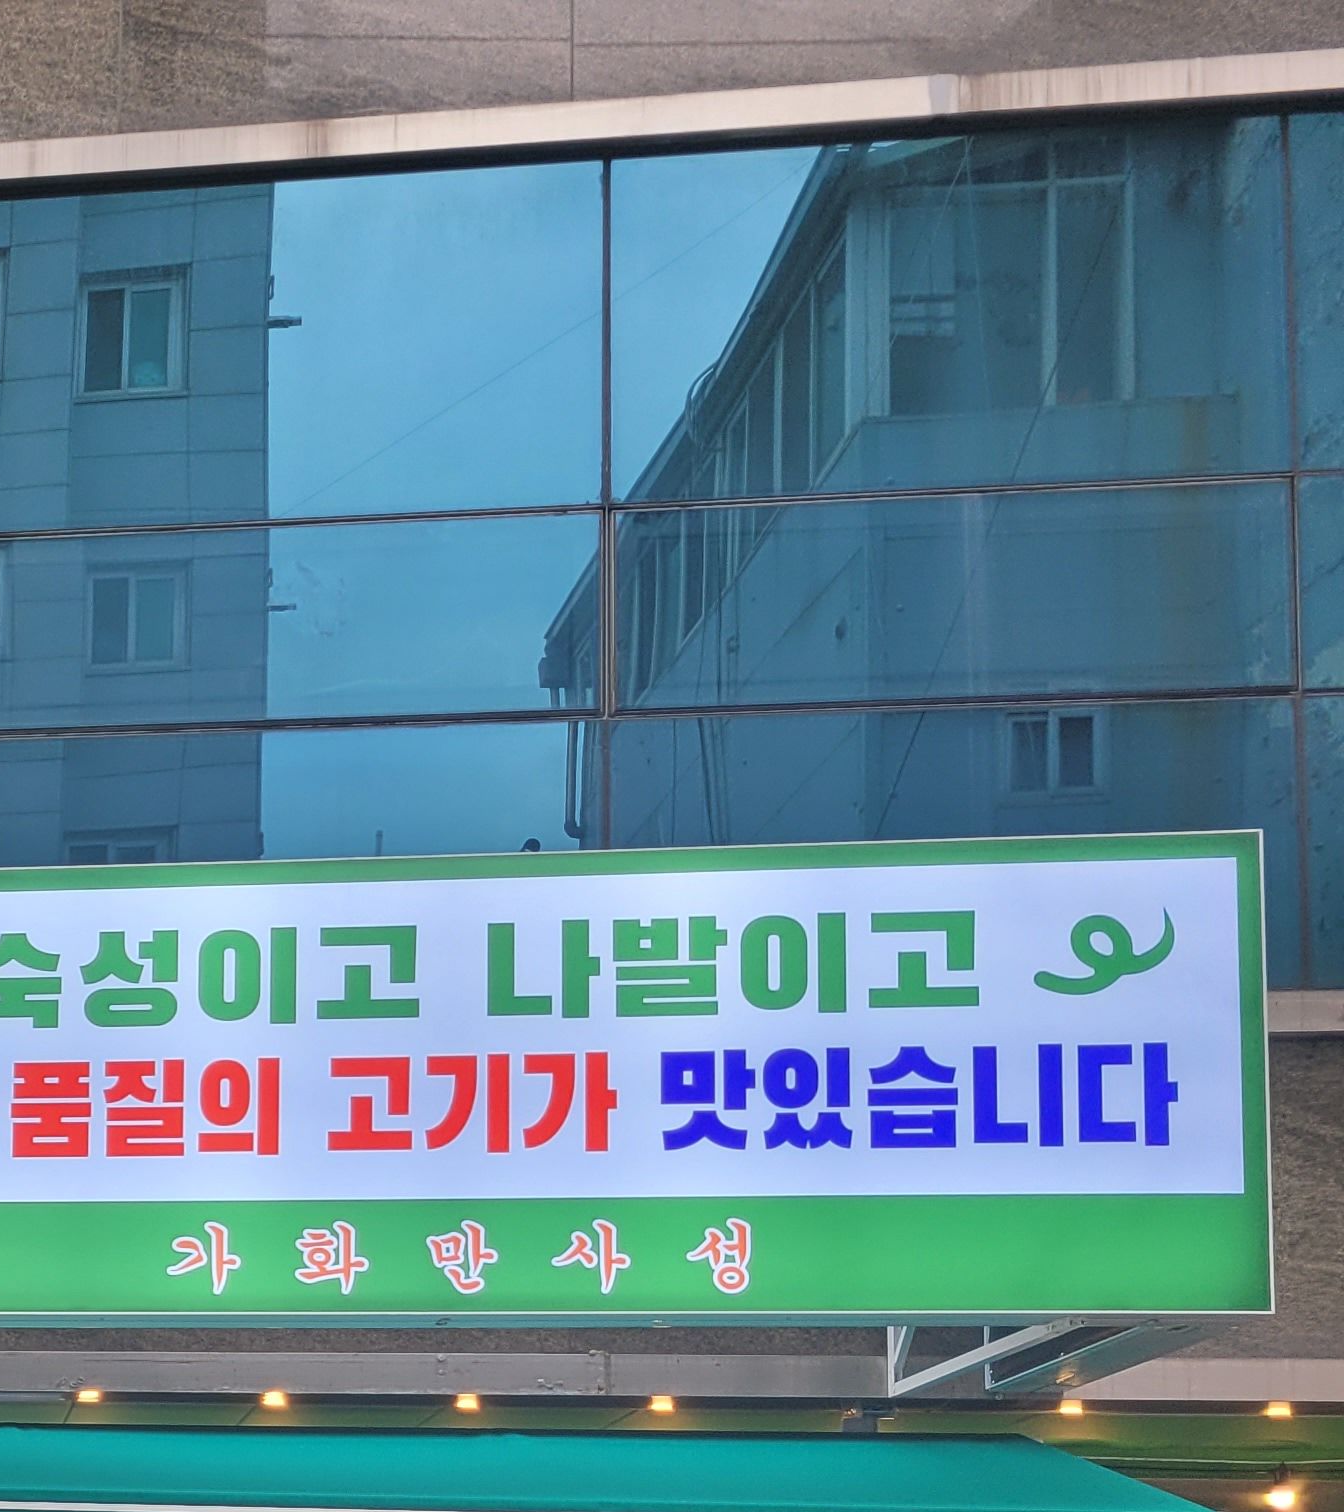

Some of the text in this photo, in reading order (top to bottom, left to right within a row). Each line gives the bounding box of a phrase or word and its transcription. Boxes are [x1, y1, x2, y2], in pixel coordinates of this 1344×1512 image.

[485, 908, 981, 1023] 나발이고
[11, 1057, 280, 1158] 품질의
[327, 1051, 619, 1156] 고기가
[657, 1041, 1178, 1153] 맛있습니다
